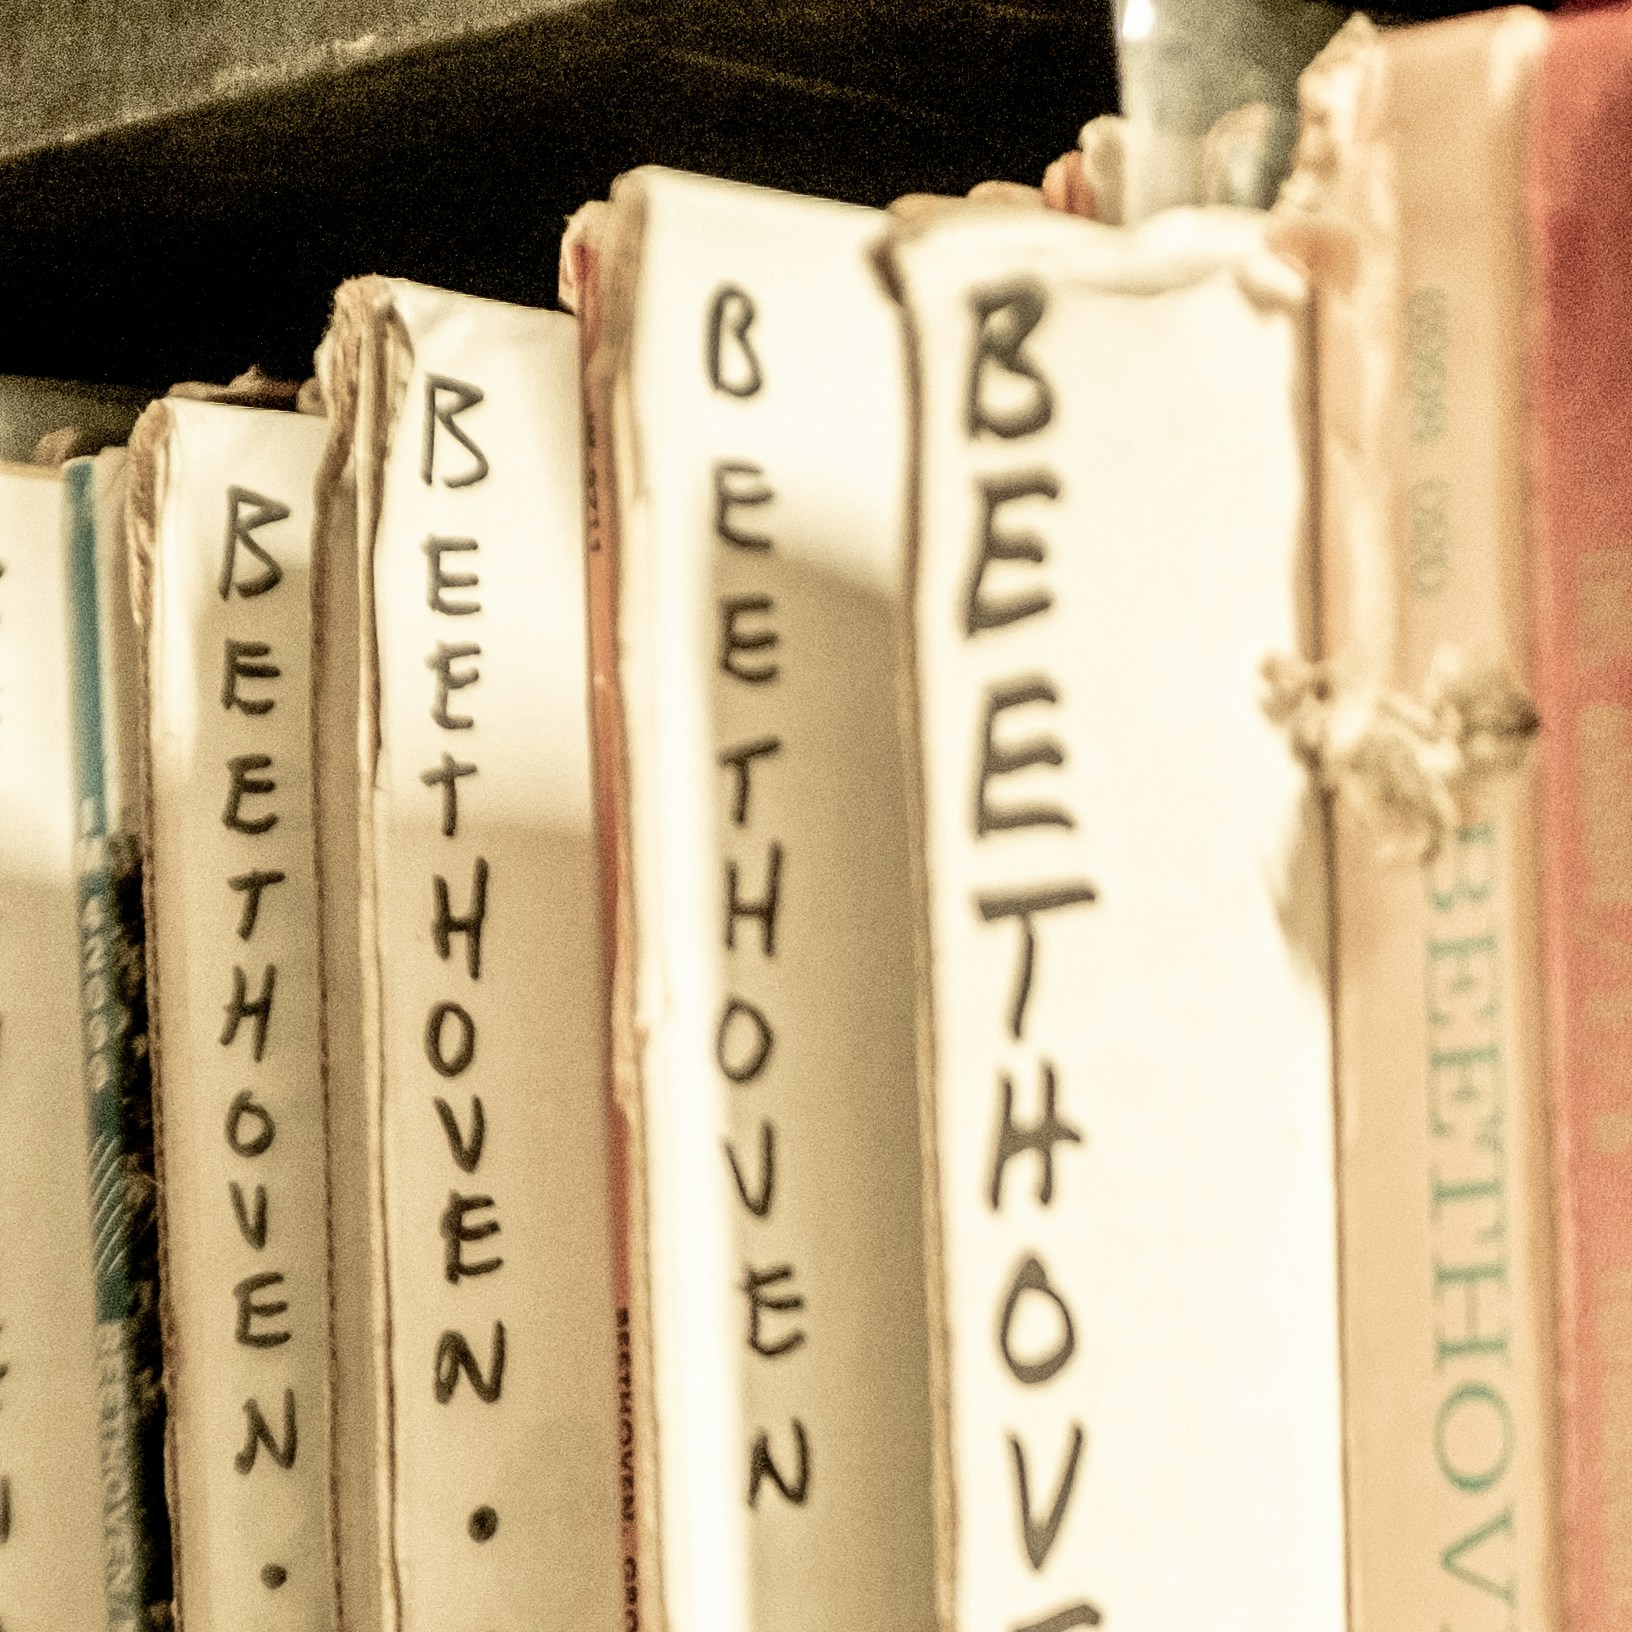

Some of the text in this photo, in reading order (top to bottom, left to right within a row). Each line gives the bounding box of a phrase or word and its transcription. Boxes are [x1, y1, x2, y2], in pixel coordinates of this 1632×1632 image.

[217, 486, 301, 1475] BEETHOVEN
[421, 374, 508, 1407] BEETHOVEN
[703, 280, 814, 1511] BEETHOVEN
